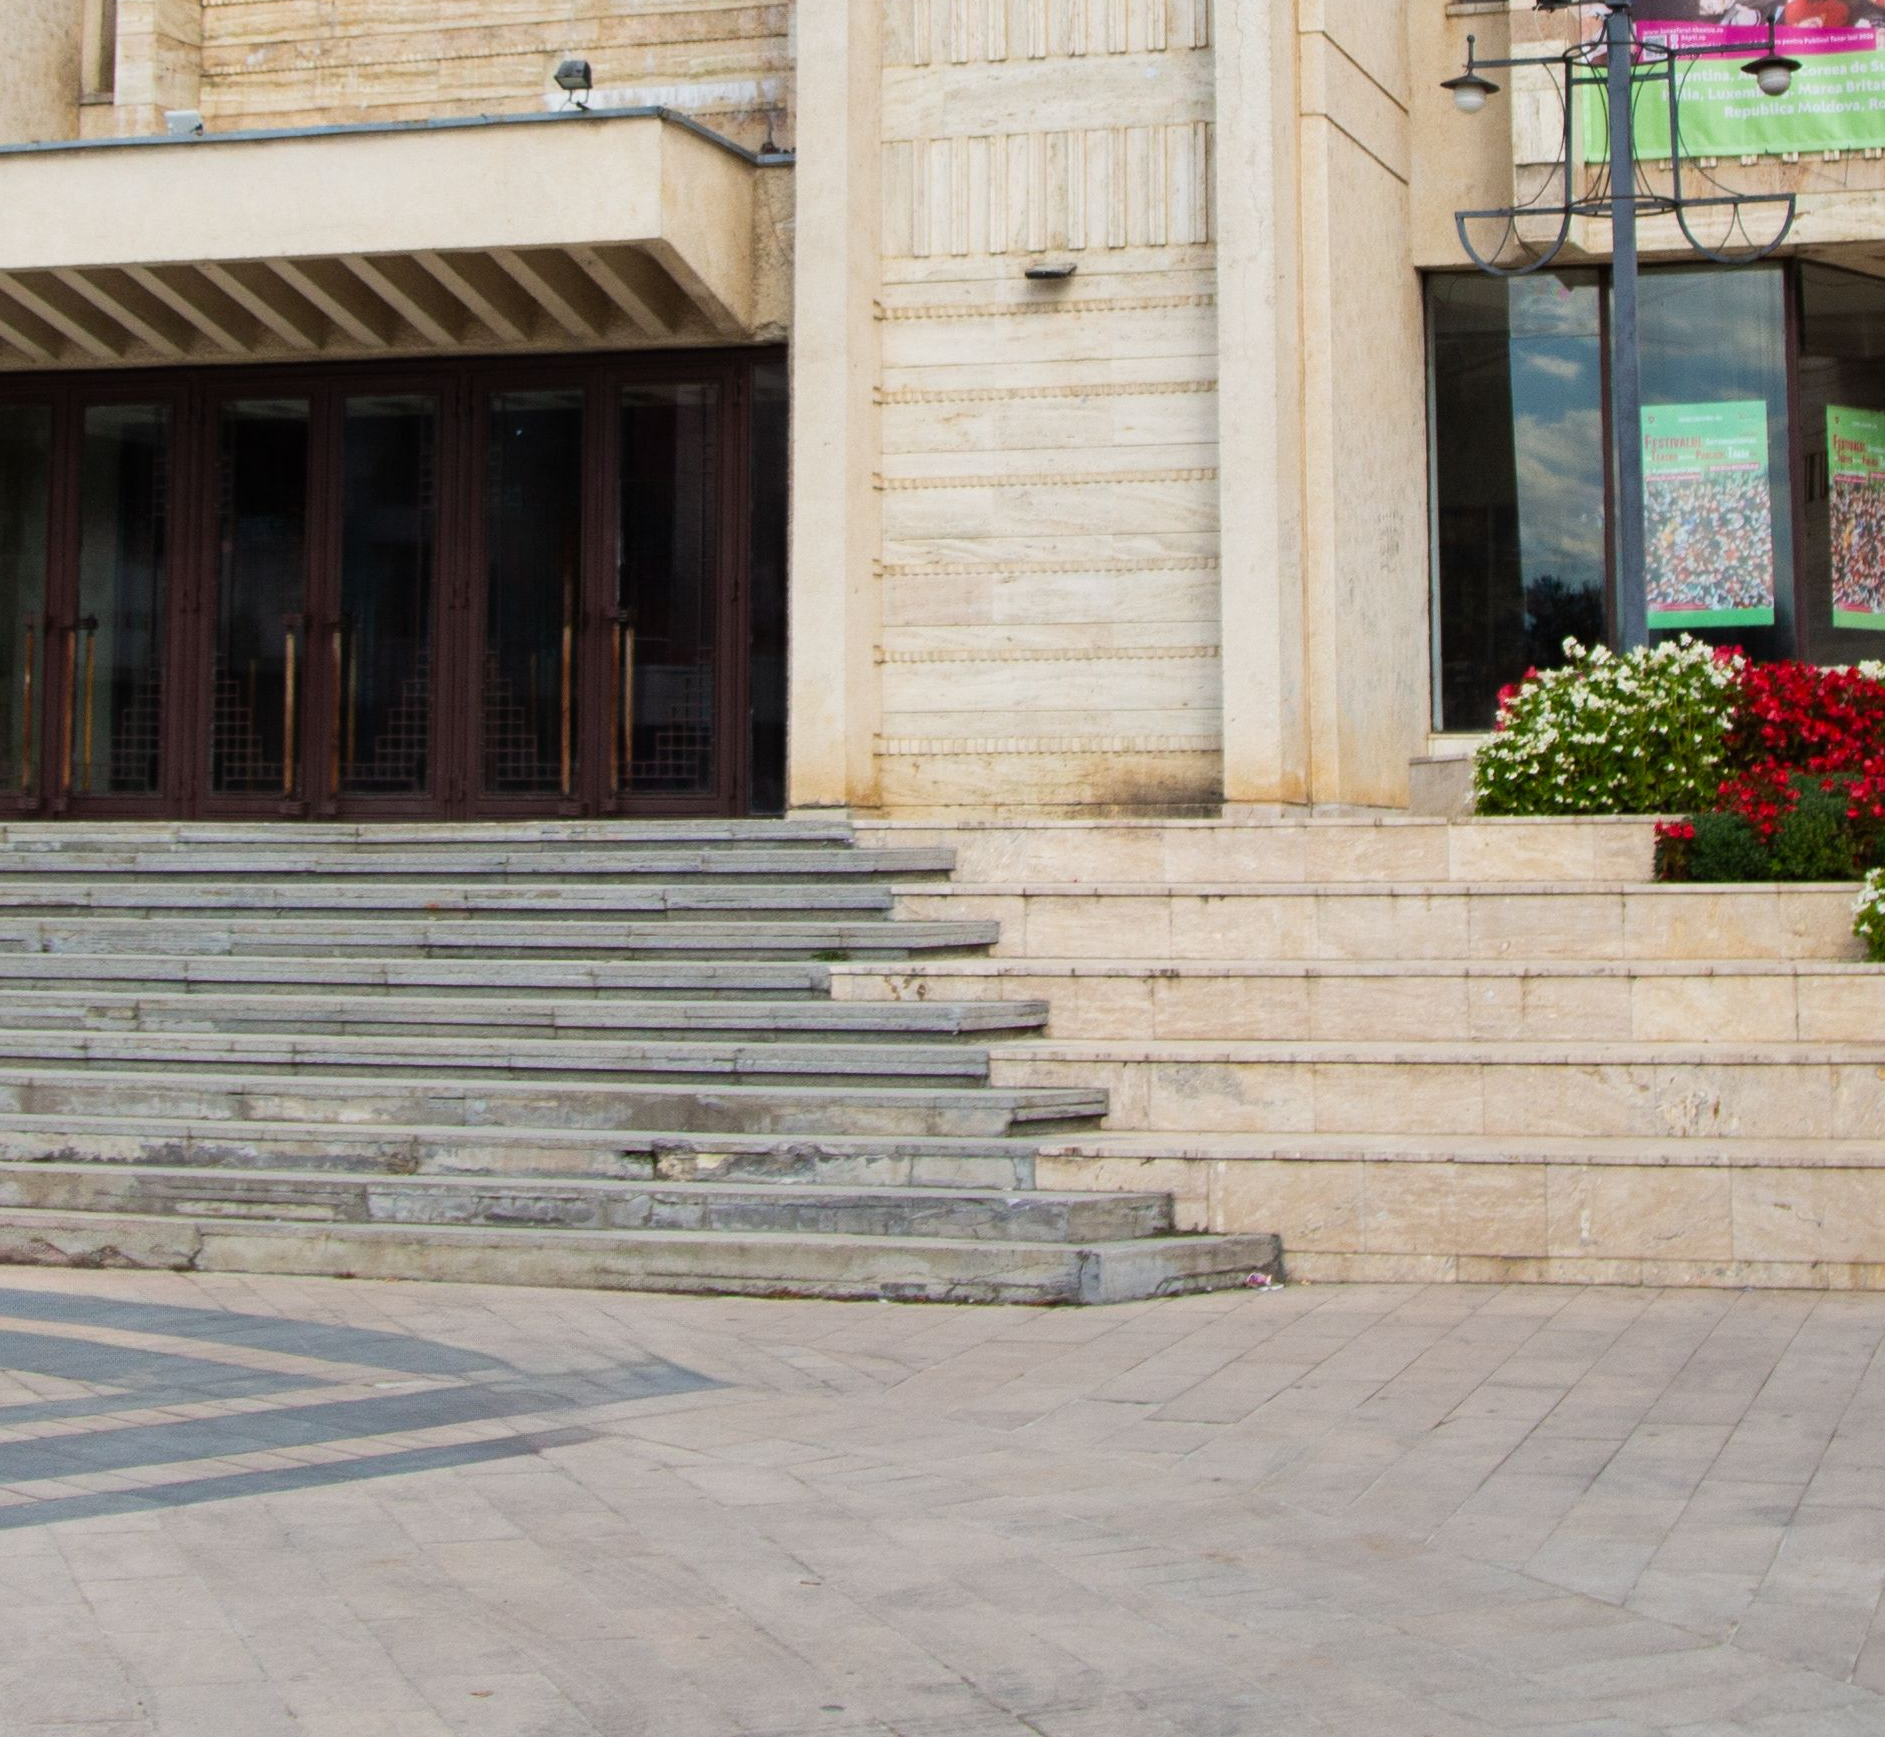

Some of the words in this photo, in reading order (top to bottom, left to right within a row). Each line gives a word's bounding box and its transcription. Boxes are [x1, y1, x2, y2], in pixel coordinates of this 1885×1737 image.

[1670, 68, 1735, 85] gentina,
[1850, 61, 1868, 74] de
[1799, 82, 1843, 96] Marea
[1724, 102, 1795, 120] Republica
